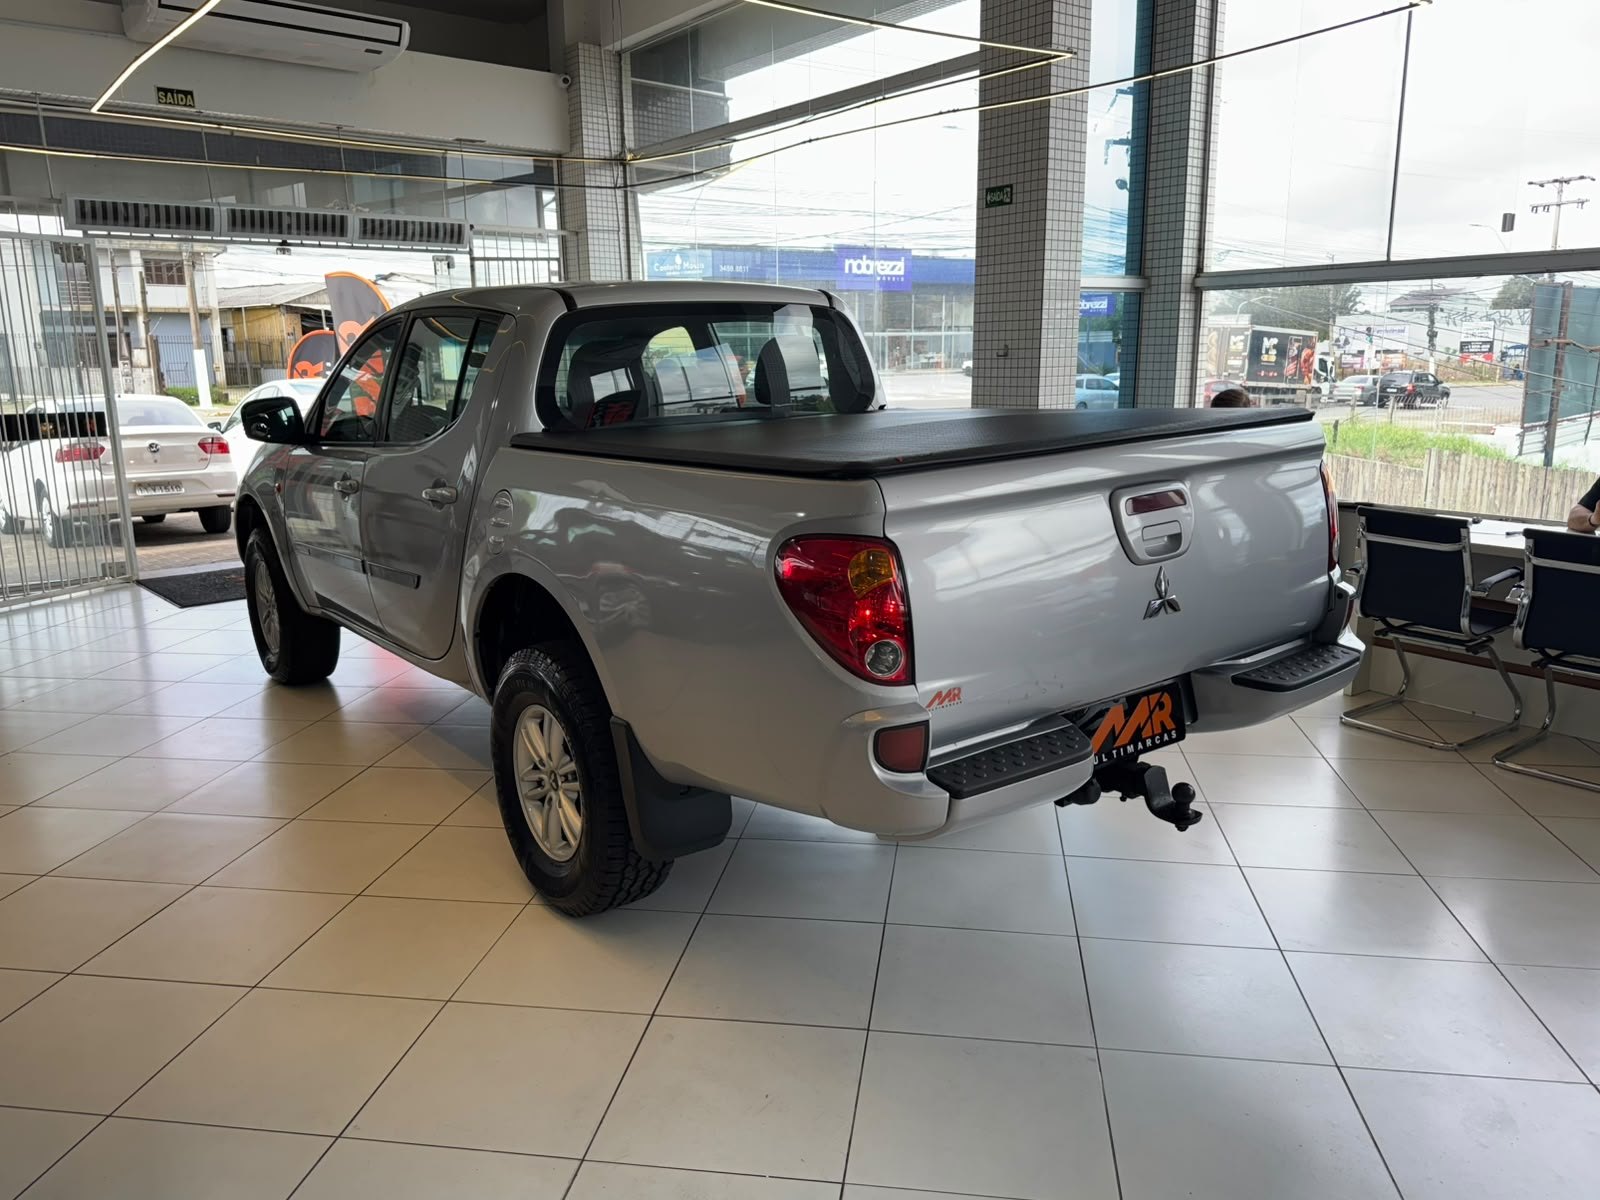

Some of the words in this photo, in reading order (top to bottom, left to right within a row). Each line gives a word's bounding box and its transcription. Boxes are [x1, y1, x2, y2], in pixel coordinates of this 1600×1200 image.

[158, 90, 194, 106] SAÍDA
[844, 254, 905, 275] nobrezzi
[1093, 729, 1177, 765] ULTIMARCAS
